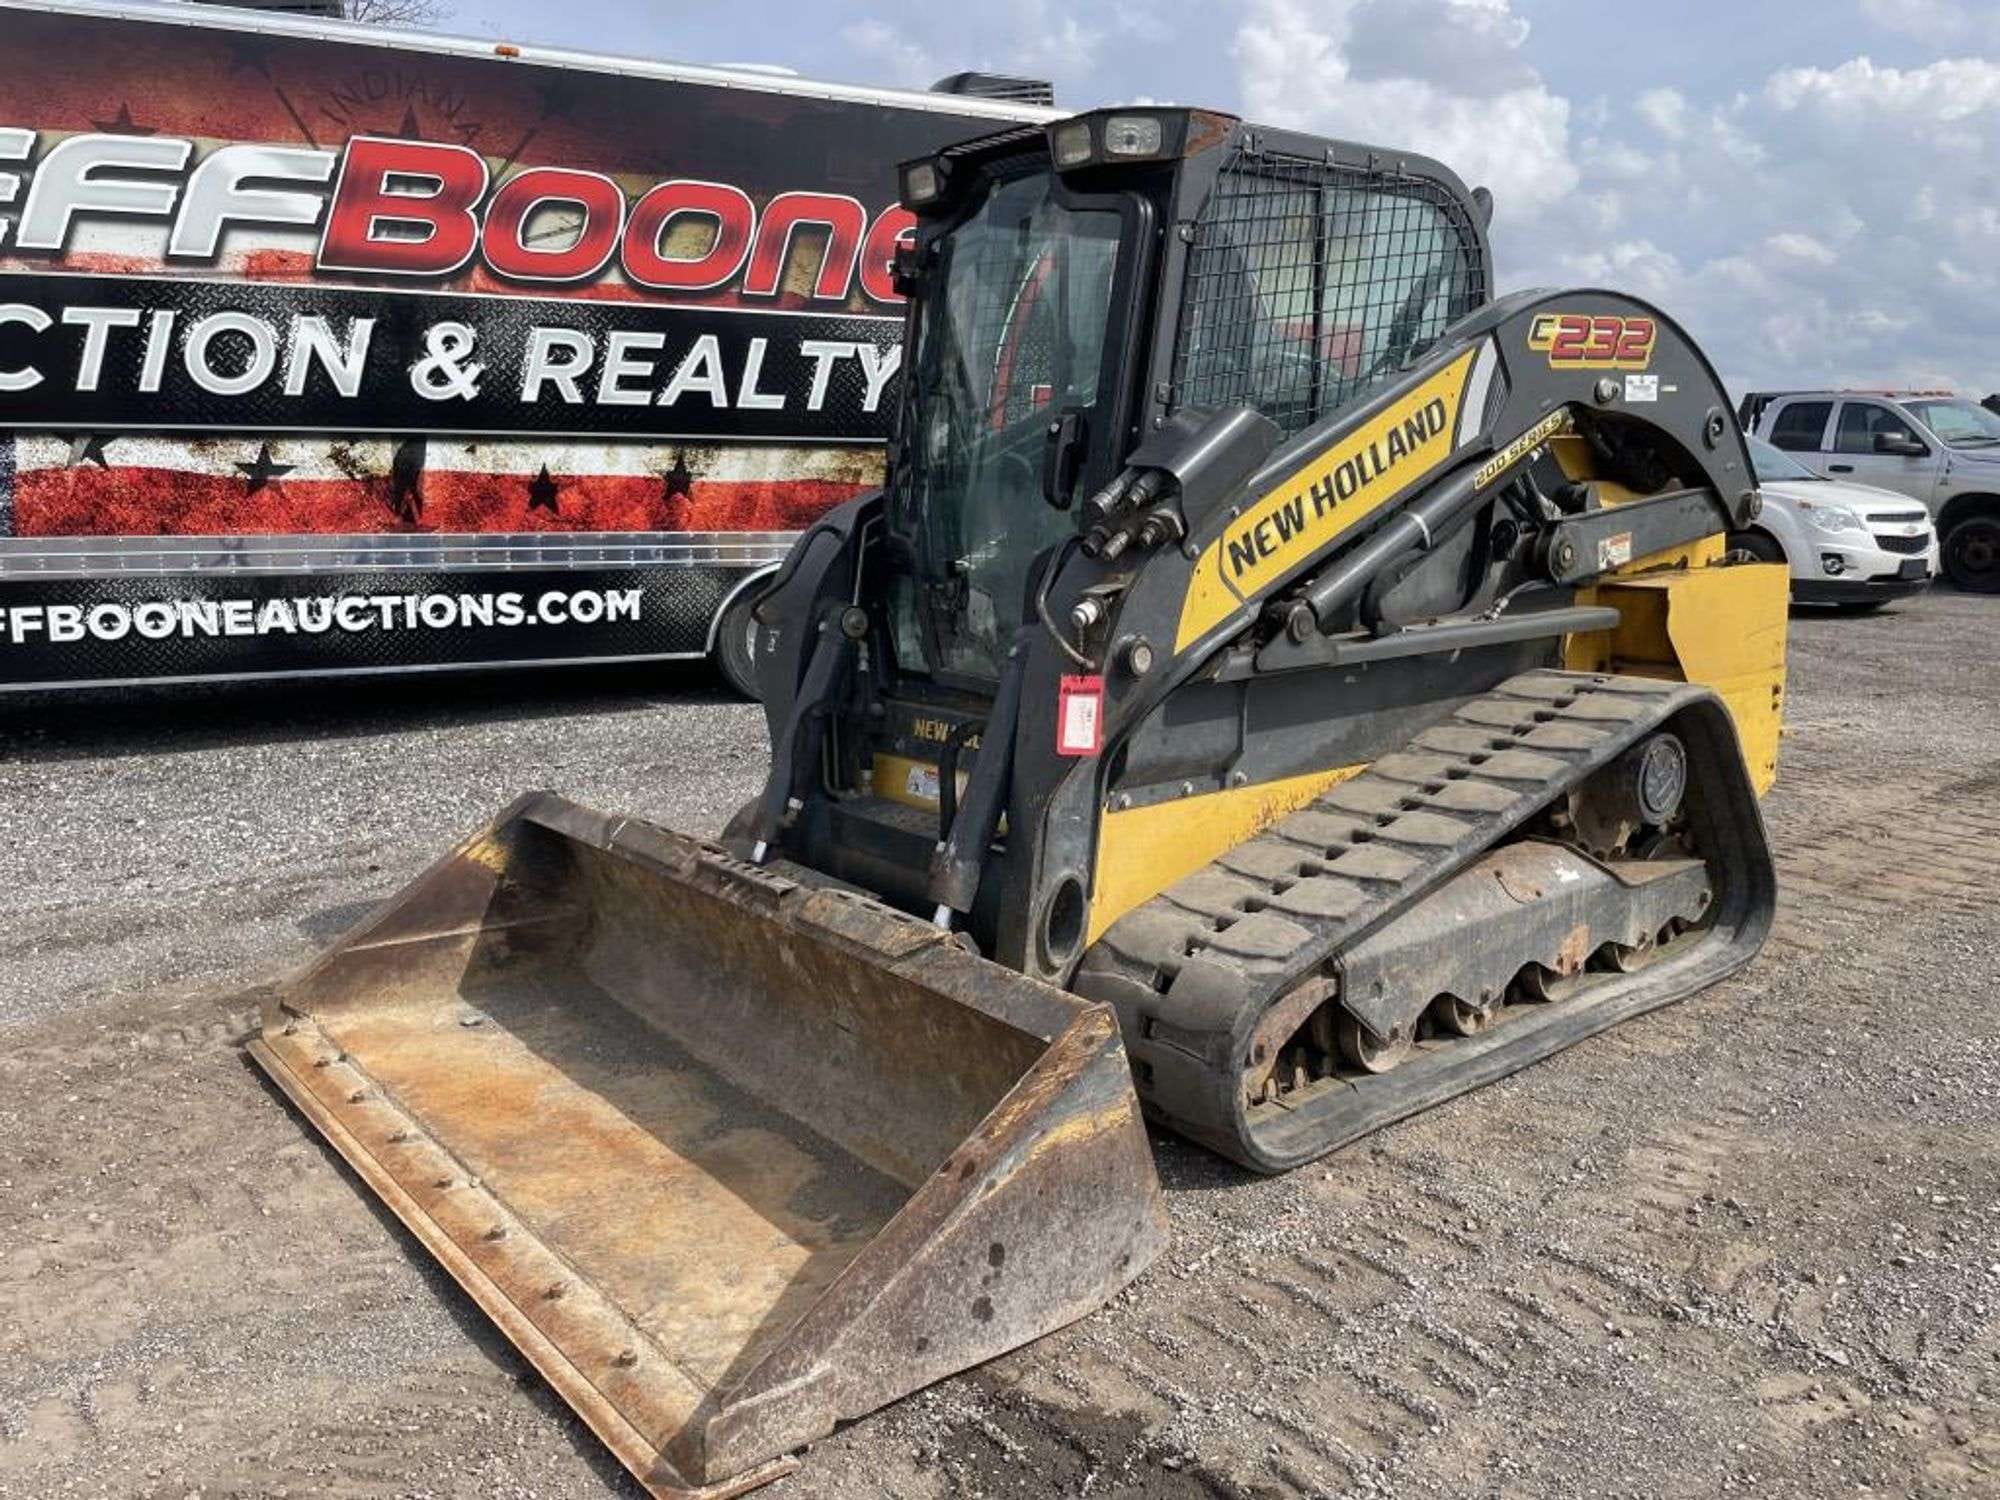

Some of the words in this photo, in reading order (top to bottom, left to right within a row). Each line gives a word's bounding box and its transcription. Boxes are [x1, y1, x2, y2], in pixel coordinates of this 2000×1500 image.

[319, 69, 484, 148] INDIANA
[410, 321, 484, 401] &
[520, 327, 903, 412] REALTY
[1228, 497, 1305, 578] NEW
[1310, 398, 1447, 518] HOLLAND
[1474, 453, 1506, 488] 200
[1509, 412, 1562, 461] SERIES
[0, 589, 643, 644] FBOONEAUCTIONS.COM
[913, 719, 949, 742] NEW
